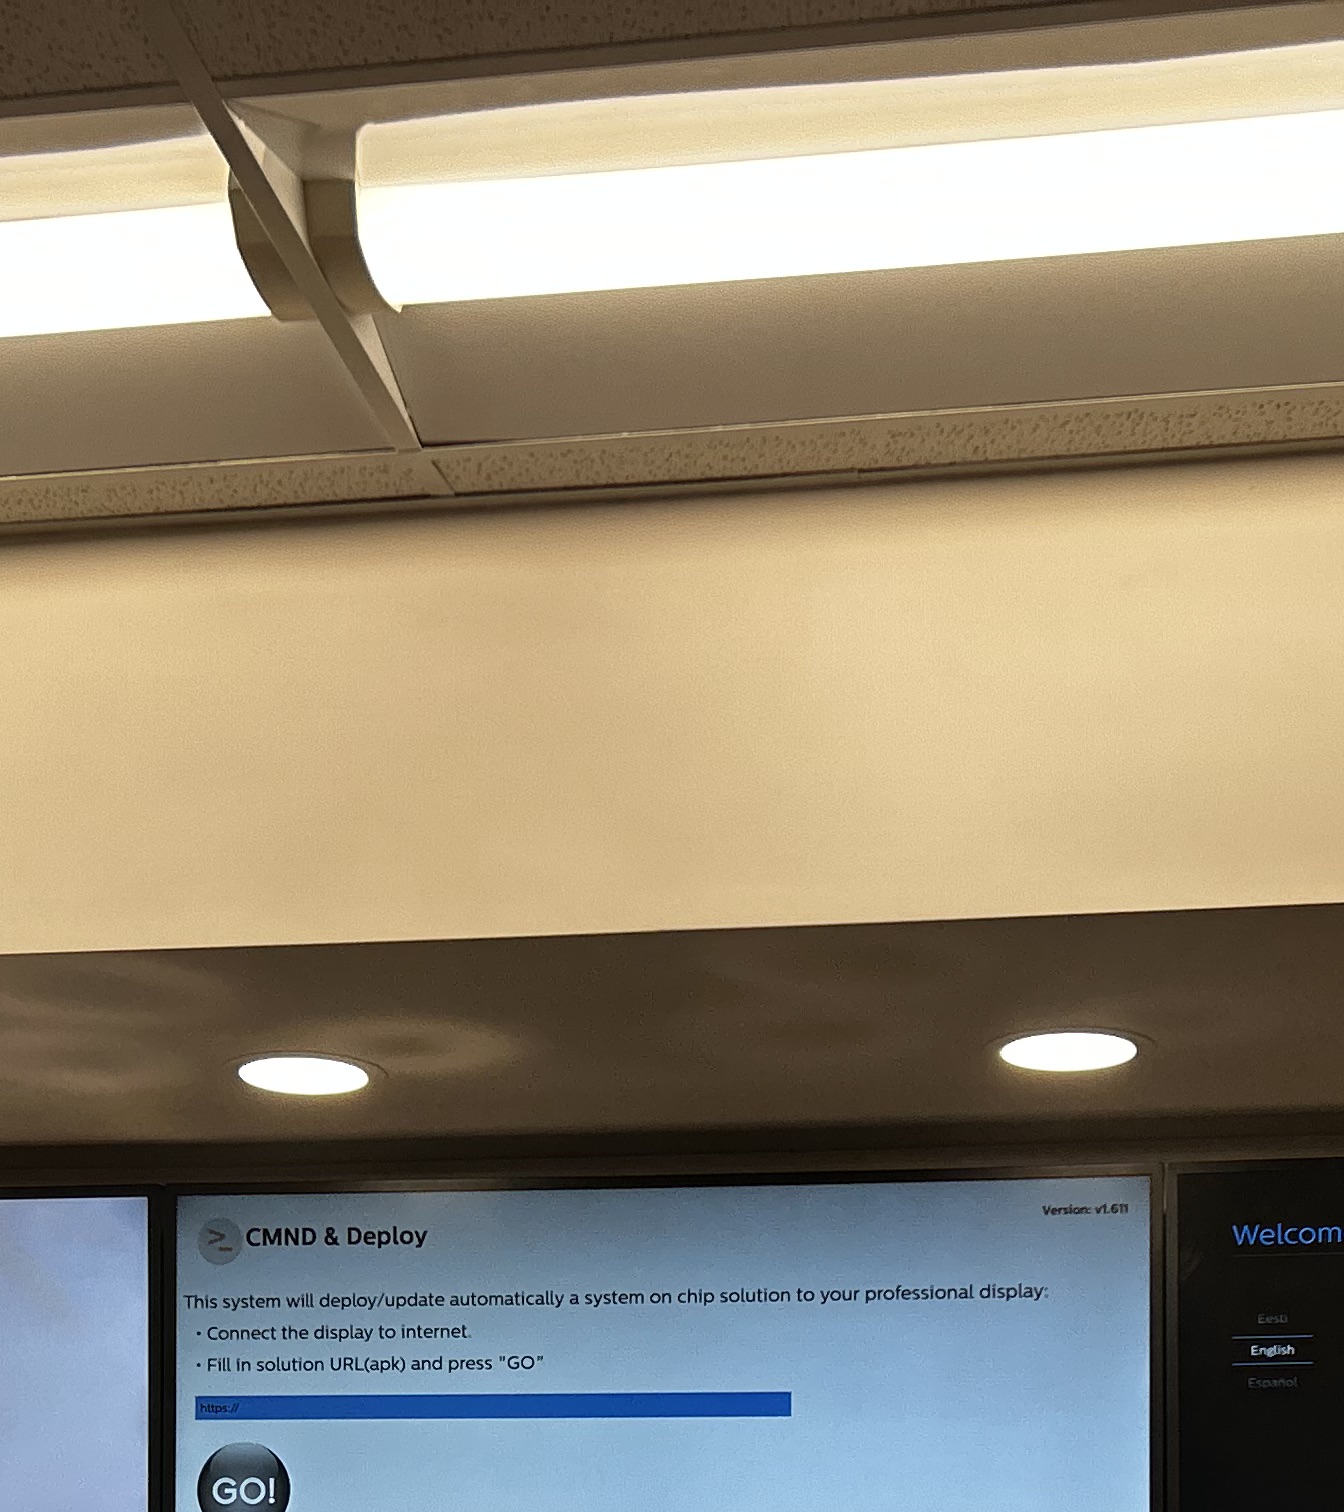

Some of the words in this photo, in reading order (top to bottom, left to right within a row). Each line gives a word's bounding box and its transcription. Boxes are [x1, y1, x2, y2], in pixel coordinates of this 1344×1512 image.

[1043, 1205, 1091, 1216] Version:
[246, 1228, 316, 1247] CMND
[324, 1228, 340, 1247] &
[347, 1226, 428, 1248] Deploy
[184, 1294, 218, 1310] This
[222, 1295, 281, 1311] system
[286, 1293, 314, 1308] will
[319, 1292, 445, 1311] deploy/update
[450, 1290, 564, 1309] automatically
[569, 1295, 580, 1306] a
[585, 1289, 644, 1308] system
[650, 1290, 672, 1304] on
[677, 1286, 715, 1306] chip
[720, 1286, 791, 1303] solution
[796, 1287, 815, 1303] to
[820, 1288, 860, 1305] your
[865, 1284, 974, 1304] professional
[979, 1282, 1049, 1302] display:
[207, 1325, 277, 1341] Connect
[281, 1325, 309, 1340] the
[313, 1324, 374, 1342] display
[378, 1325, 396, 1340] to
[401, 1323, 472, 1340] internet.
[1251, 1344, 1295, 1358] English
[207, 1356, 231, 1372] Fill
[236, 1356, 252, 1372] in
[256, 1356, 324, 1372] solution
[330, 1355, 406, 1374] URL(apk)
[411, 1355, 443, 1371] and
[448, 1358, 493, 1374] press
[200, 1401, 240, 1415] https://
[211, 1475, 276, 1507] GO!
